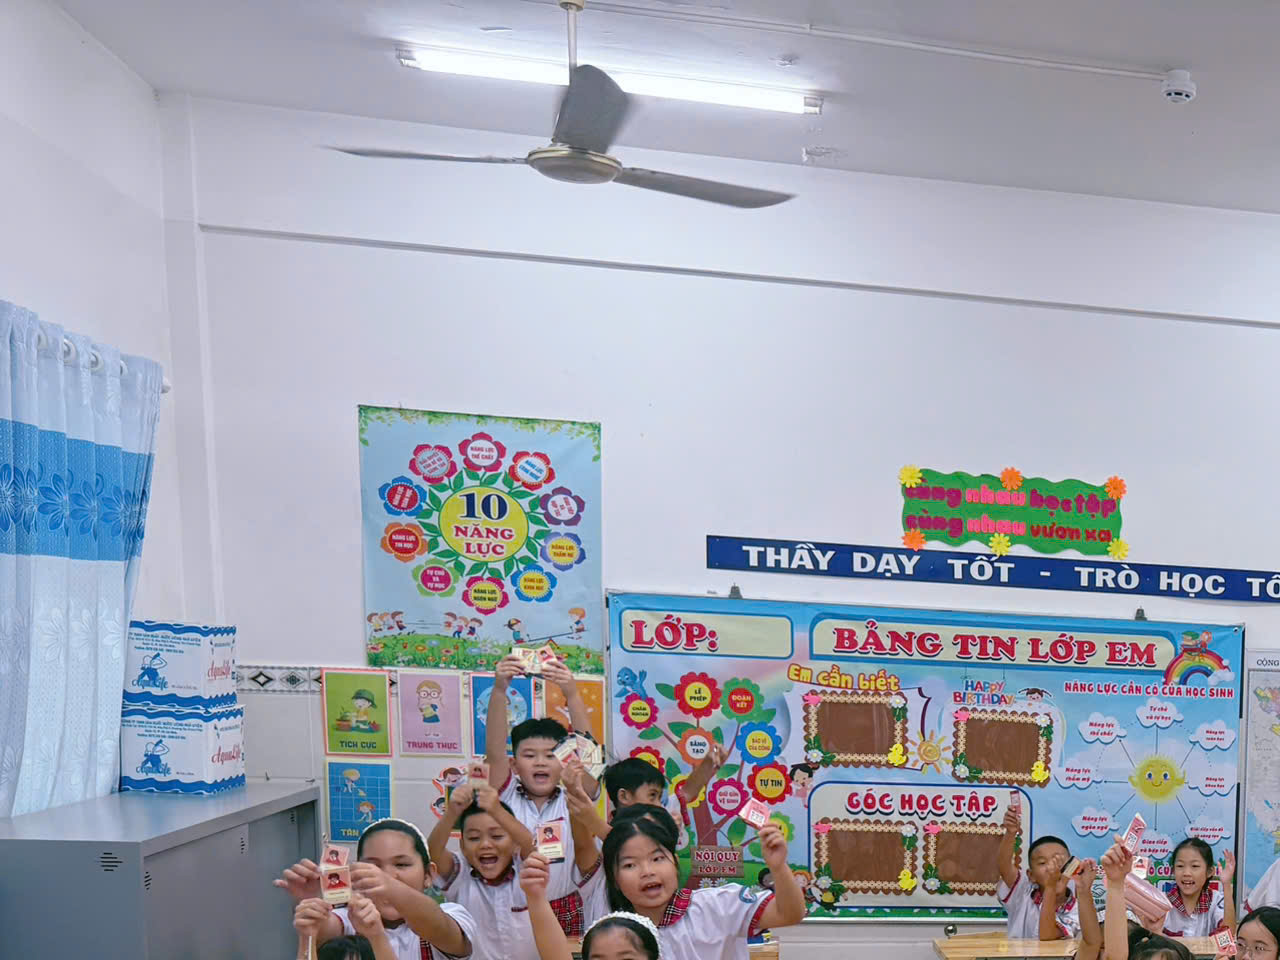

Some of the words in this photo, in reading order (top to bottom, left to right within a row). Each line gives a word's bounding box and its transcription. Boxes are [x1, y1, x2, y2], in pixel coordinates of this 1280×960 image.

[460, 492, 508, 520] 10
[965, 484, 1026, 507] nhau
[1030, 489, 1072, 516] học
[1074, 493, 1116, 519] tập
[454, 523, 514, 540] NĂNG
[967, 514, 1026, 536] nhau
[1030, 523, 1081, 541] vươn
[1085, 529, 1113, 543] xa
[465, 542, 504, 558] LỰC
[742, 542, 835, 571] THẦY
[852, 551, 920, 577] DẠY
[947, 554, 1015, 583] TỐT
[1074, 564, 1140, 589] TRÒ
[1159, 571, 1225, 598] HỌC
[630, 614, 719, 652] LỚP:
[834, 620, 943, 657] BẢNG
[952, 632, 1019, 661] TIN
[1028, 633, 1097, 664] LỚP
[1106, 642, 1158, 666] EM
[1256, 658, 1280, 668] CỘNG
[788, 662, 813, 682] Em
[817, 664, 853, 690] cần
[858, 669, 900, 692] biết
[964, 679, 1005, 694] HAPPY
[1064, 682, 1094, 693] NĂNG
[1097, 683, 1118, 696] LỰC
[1146, 683, 1159, 696] CÓ
[1162, 684, 1183, 697] CỦA
[1186, 687, 1206, 698] HỌC
[1209, 686, 1234, 698] SINH
[952, 692, 1015, 706] BIRTHDAY
[406, 741, 435, 750] TRUNG
[759, 778, 770, 789] TỰ
[770, 778, 783, 787] TIN
[846, 788, 894, 815] GÓC
[900, 794, 946, 819] HỌC
[951, 790, 998, 819] TẬP
[695, 850, 715, 862] NỘI
[716, 852, 740, 862] QUY
